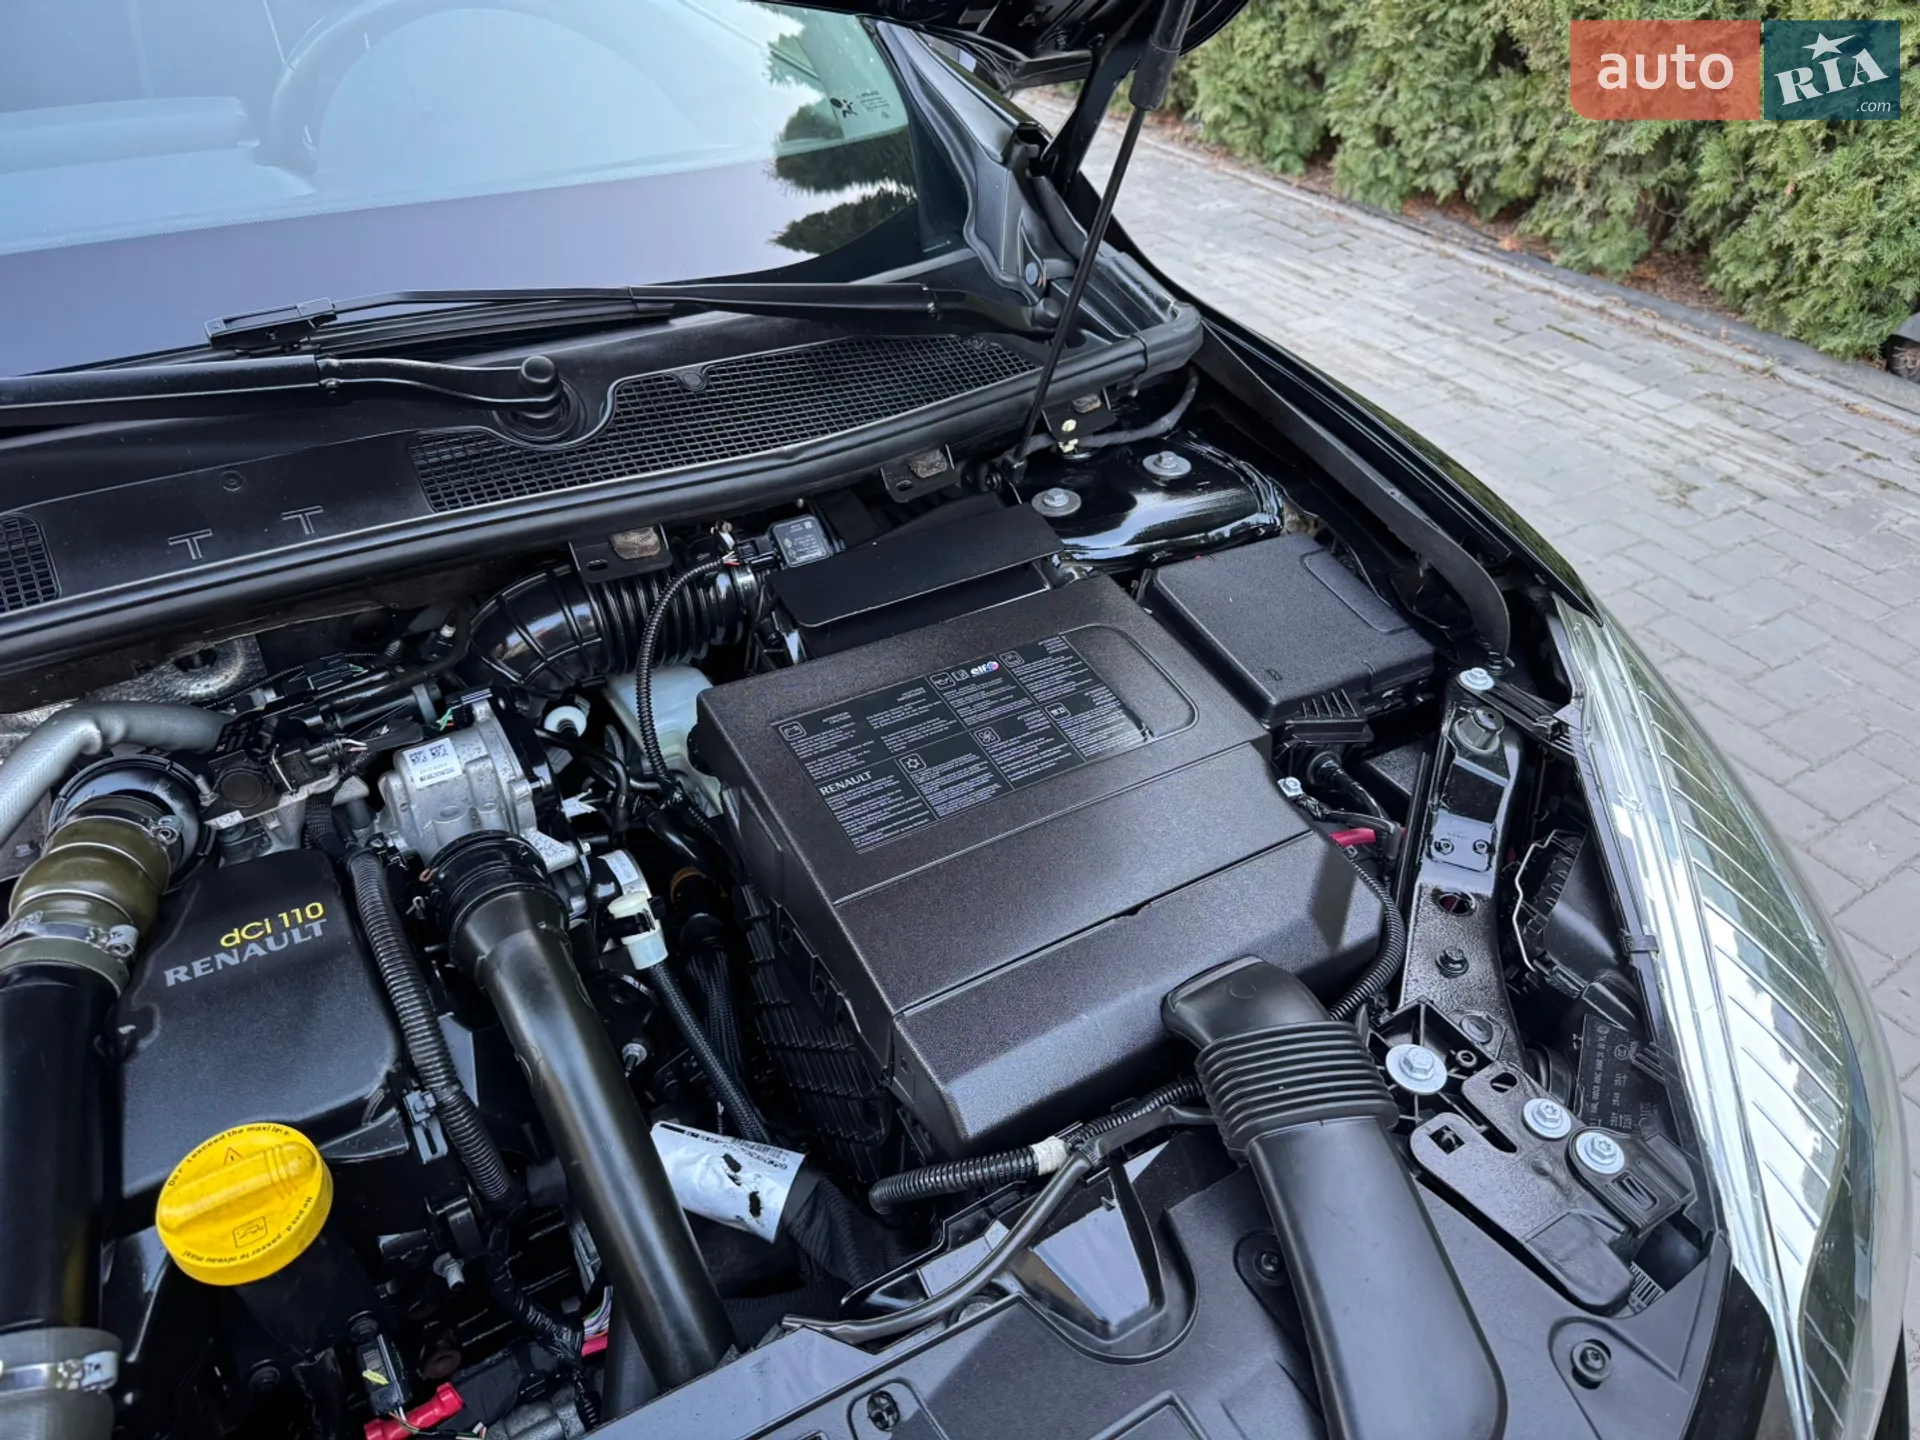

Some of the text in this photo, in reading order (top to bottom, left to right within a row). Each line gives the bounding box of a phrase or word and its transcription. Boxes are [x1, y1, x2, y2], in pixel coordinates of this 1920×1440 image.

[819, 771, 872, 795] RENAULT
[220, 902, 324, 947] dCi 110
[164, 919, 327, 987] RENAULT
[191, 1134, 226, 1159] exceed
[227, 1128, 244, 1138] the
[182, 1250, 205, 1262] maxi
